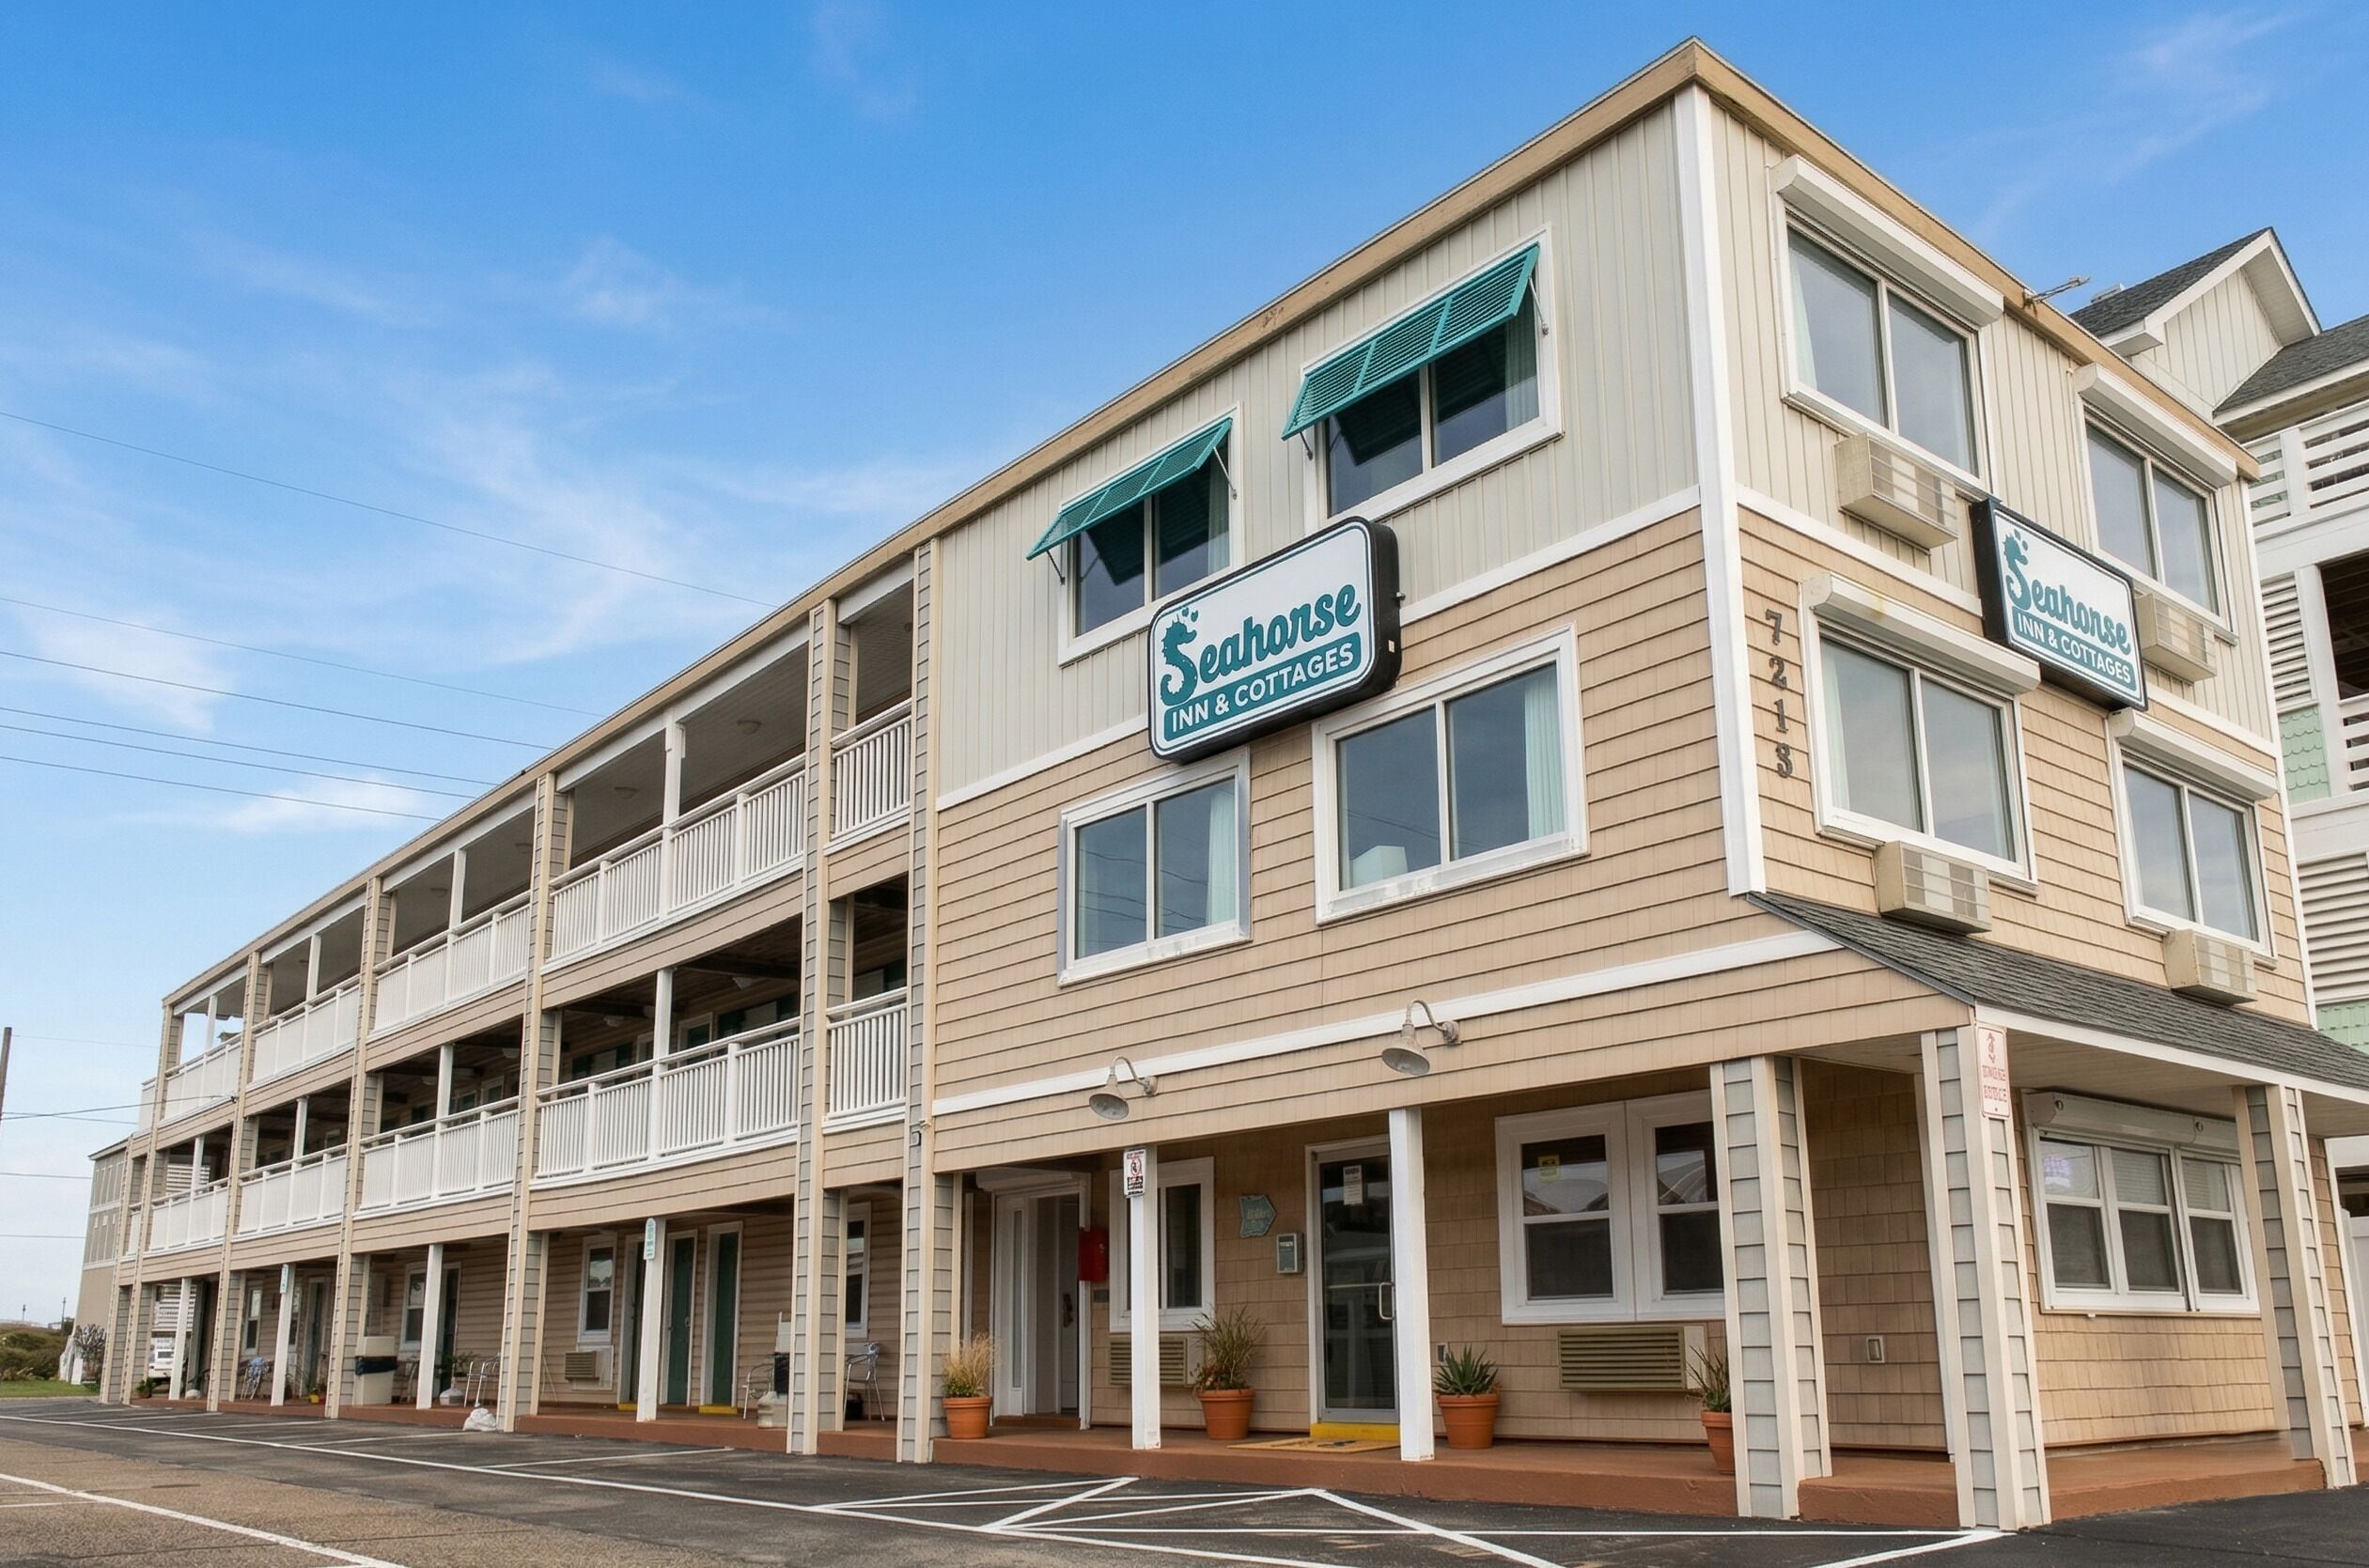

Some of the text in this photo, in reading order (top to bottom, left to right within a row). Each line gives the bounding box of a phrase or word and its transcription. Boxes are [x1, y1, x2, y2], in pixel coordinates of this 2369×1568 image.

[1160, 584, 1362, 706] Seahorse
[2003, 532, 2131, 656] Seahorse
[1172, 642, 1354, 733] INN & COTTAGES
[2018, 613, 2131, 683] INN & COTTAGES
